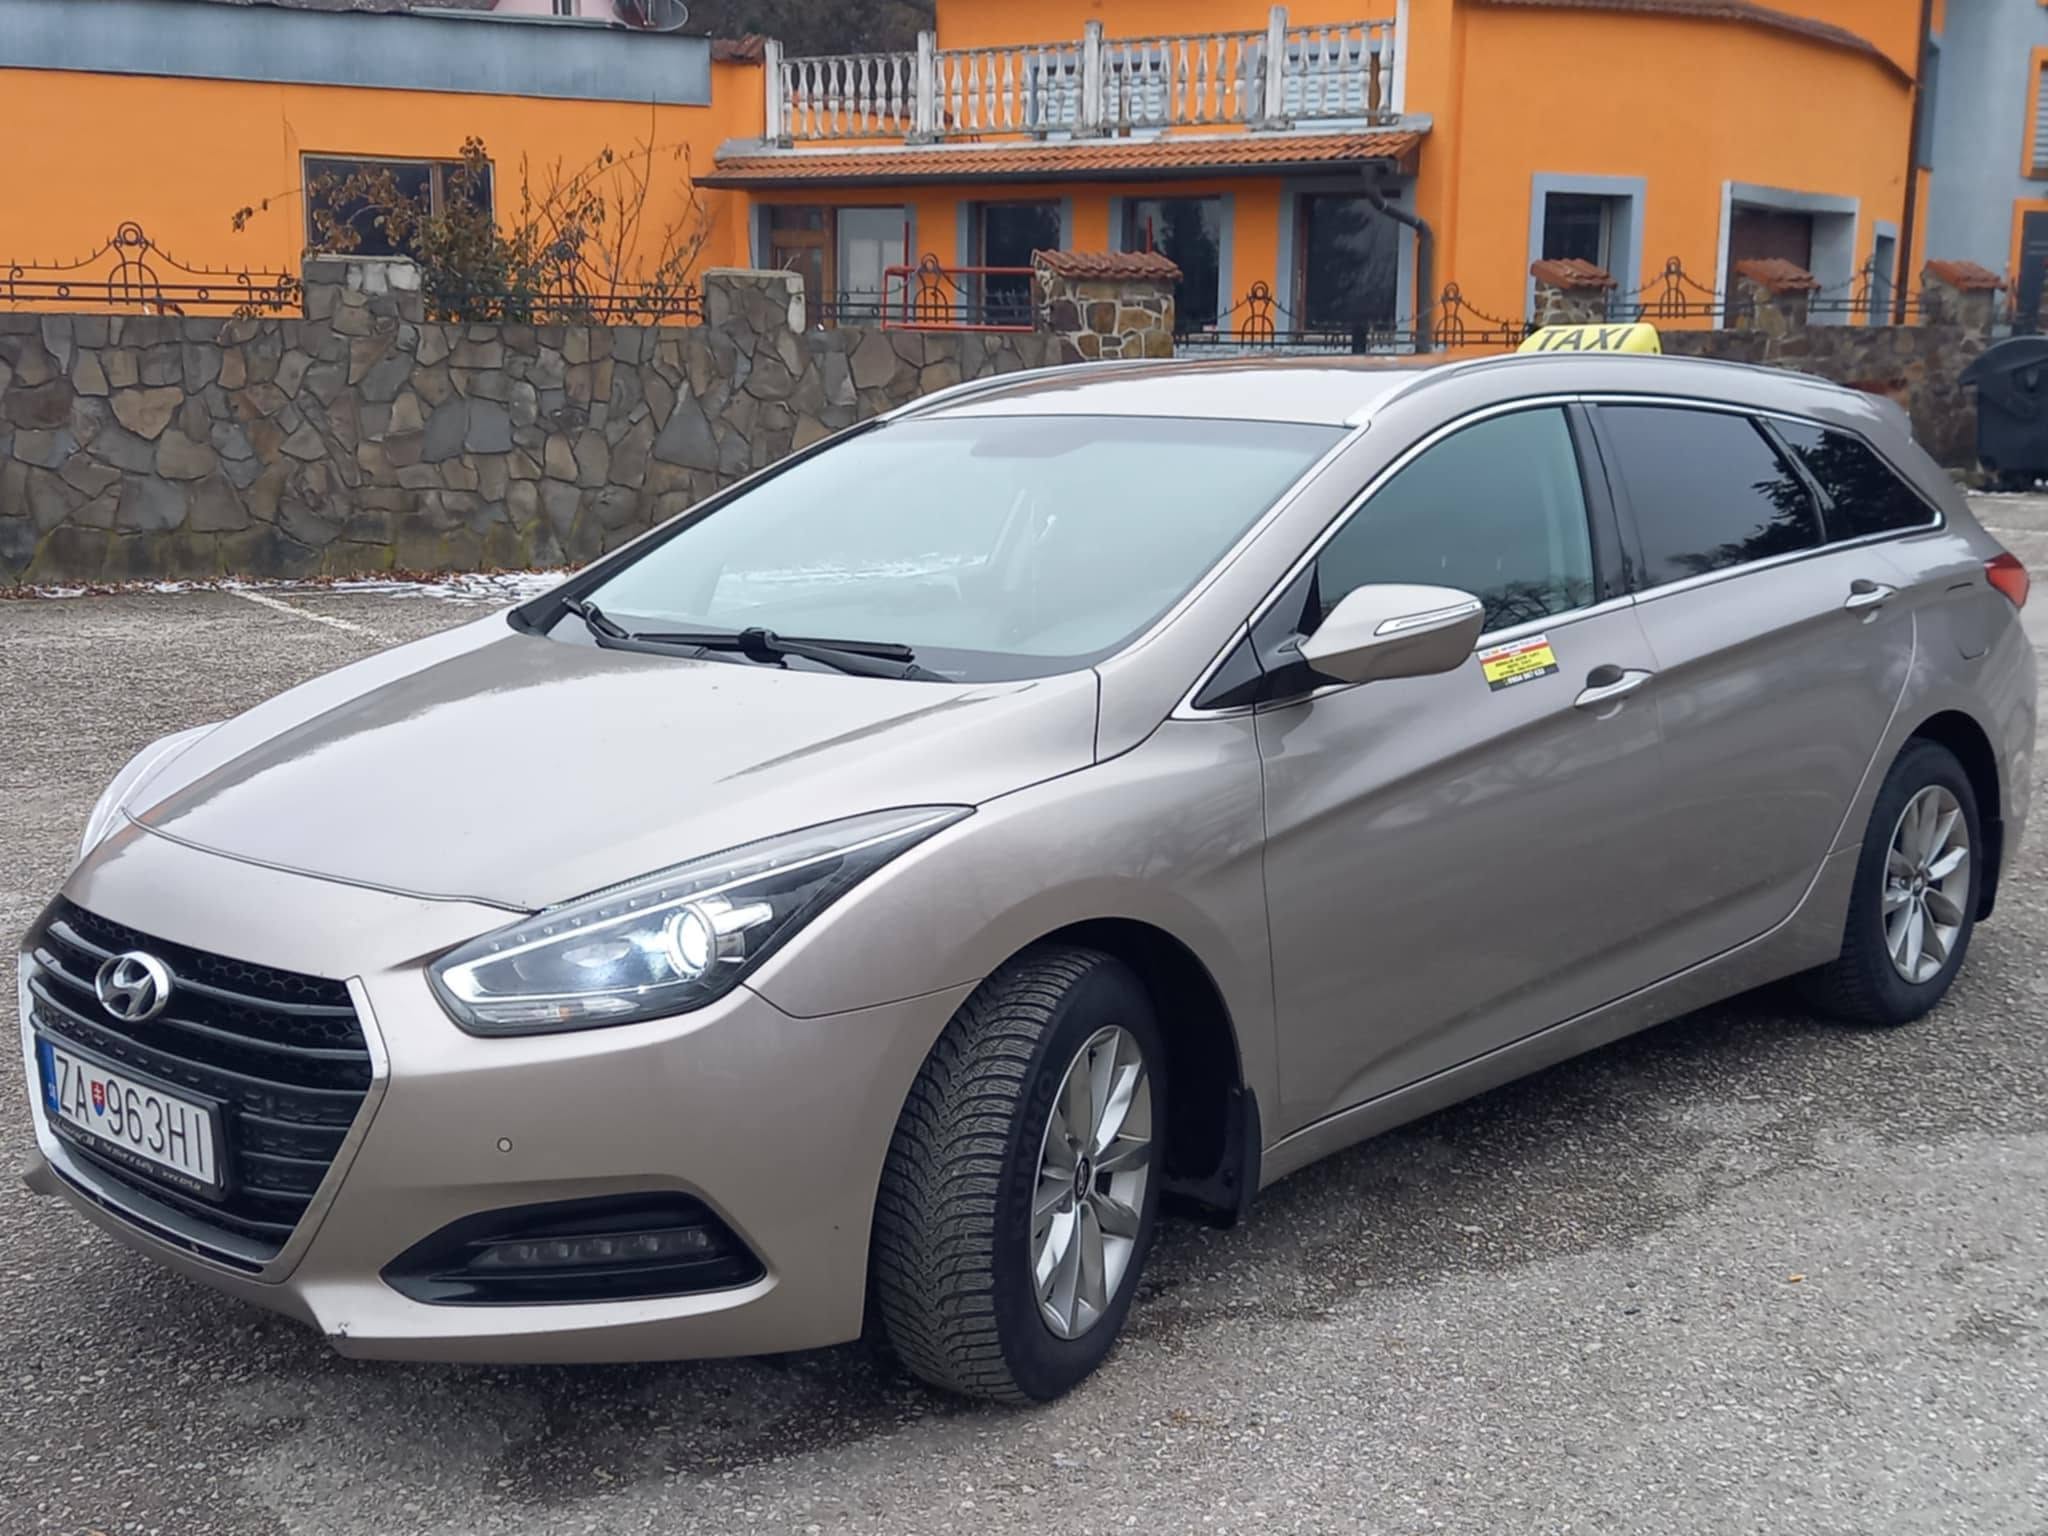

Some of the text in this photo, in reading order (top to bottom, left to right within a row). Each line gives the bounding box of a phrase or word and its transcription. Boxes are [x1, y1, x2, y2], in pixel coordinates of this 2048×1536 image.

[1538, 328, 1634, 351] TAXI
[56, 1054, 204, 1173] ZA 963HI
